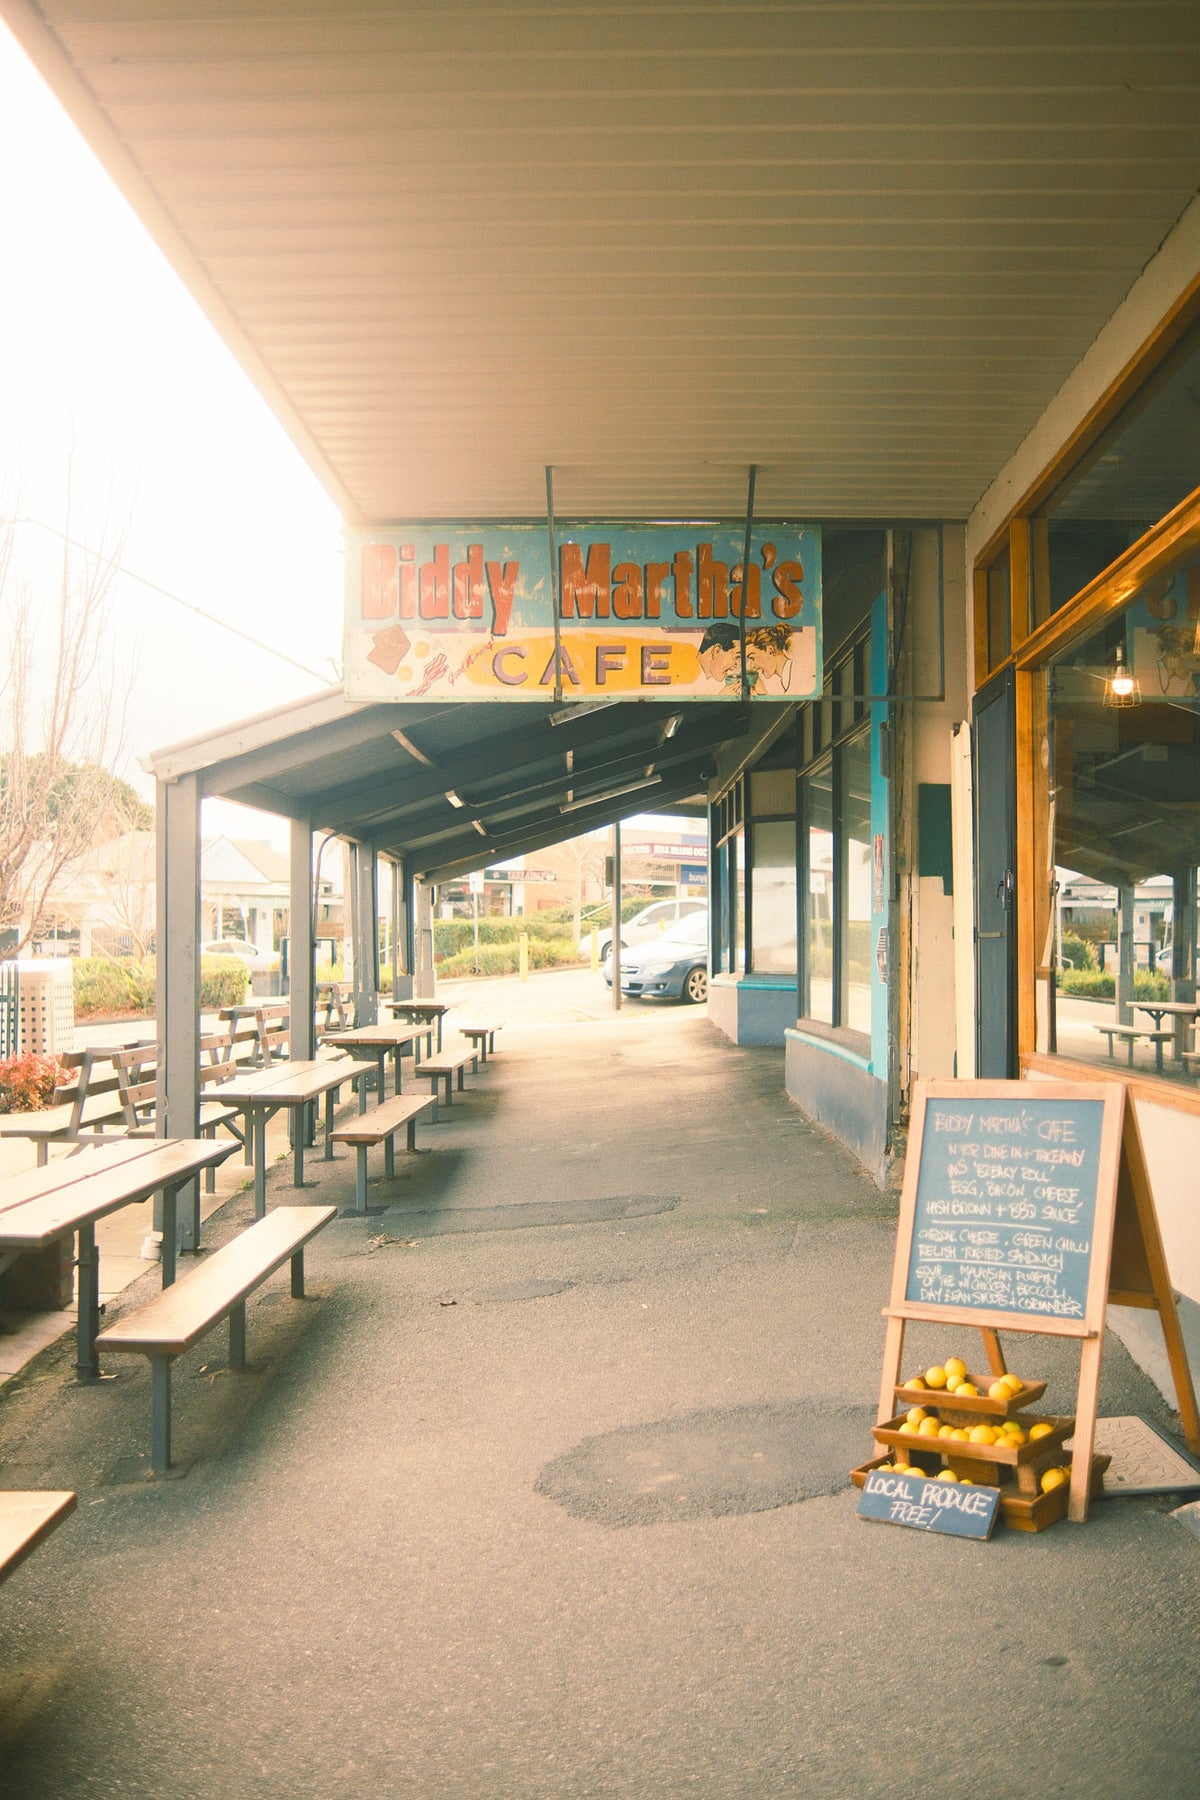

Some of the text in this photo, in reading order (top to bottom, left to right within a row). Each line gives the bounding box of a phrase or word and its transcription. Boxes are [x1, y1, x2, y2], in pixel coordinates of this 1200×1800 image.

[361, 541, 804, 636] Biddy Martha's
[491, 645, 673, 686] CAFE
[934, 1112, 974, 1136] BIDDY
[1037, 1120, 1077, 1143] CAFE
[983, 1145, 1008, 1160] DINE
[1011, 1146, 1022, 1159] IN
[926, 1201, 949, 1215] HASH
[952, 1199, 991, 1216] BROWN
[996, 1204, 1005, 1217] +
[1041, 1206, 1079, 1224] SAUCE
[1012, 1233, 1052, 1249] GREEN
[918, 1244, 1063, 1269] RELISH TOASTED SANDWICH
[915, 1264, 942, 1279] SOUP
[922, 1274, 956, 1287] OF THE
[920, 1288, 942, 1302] DAY
[944, 1289, 971, 1303] BEAN
[1018, 1297, 1084, 1317] CORIANDER
[866, 1476, 992, 1517] LOCAL PRODUCE
[890, 1501, 942, 1529] FREE!
